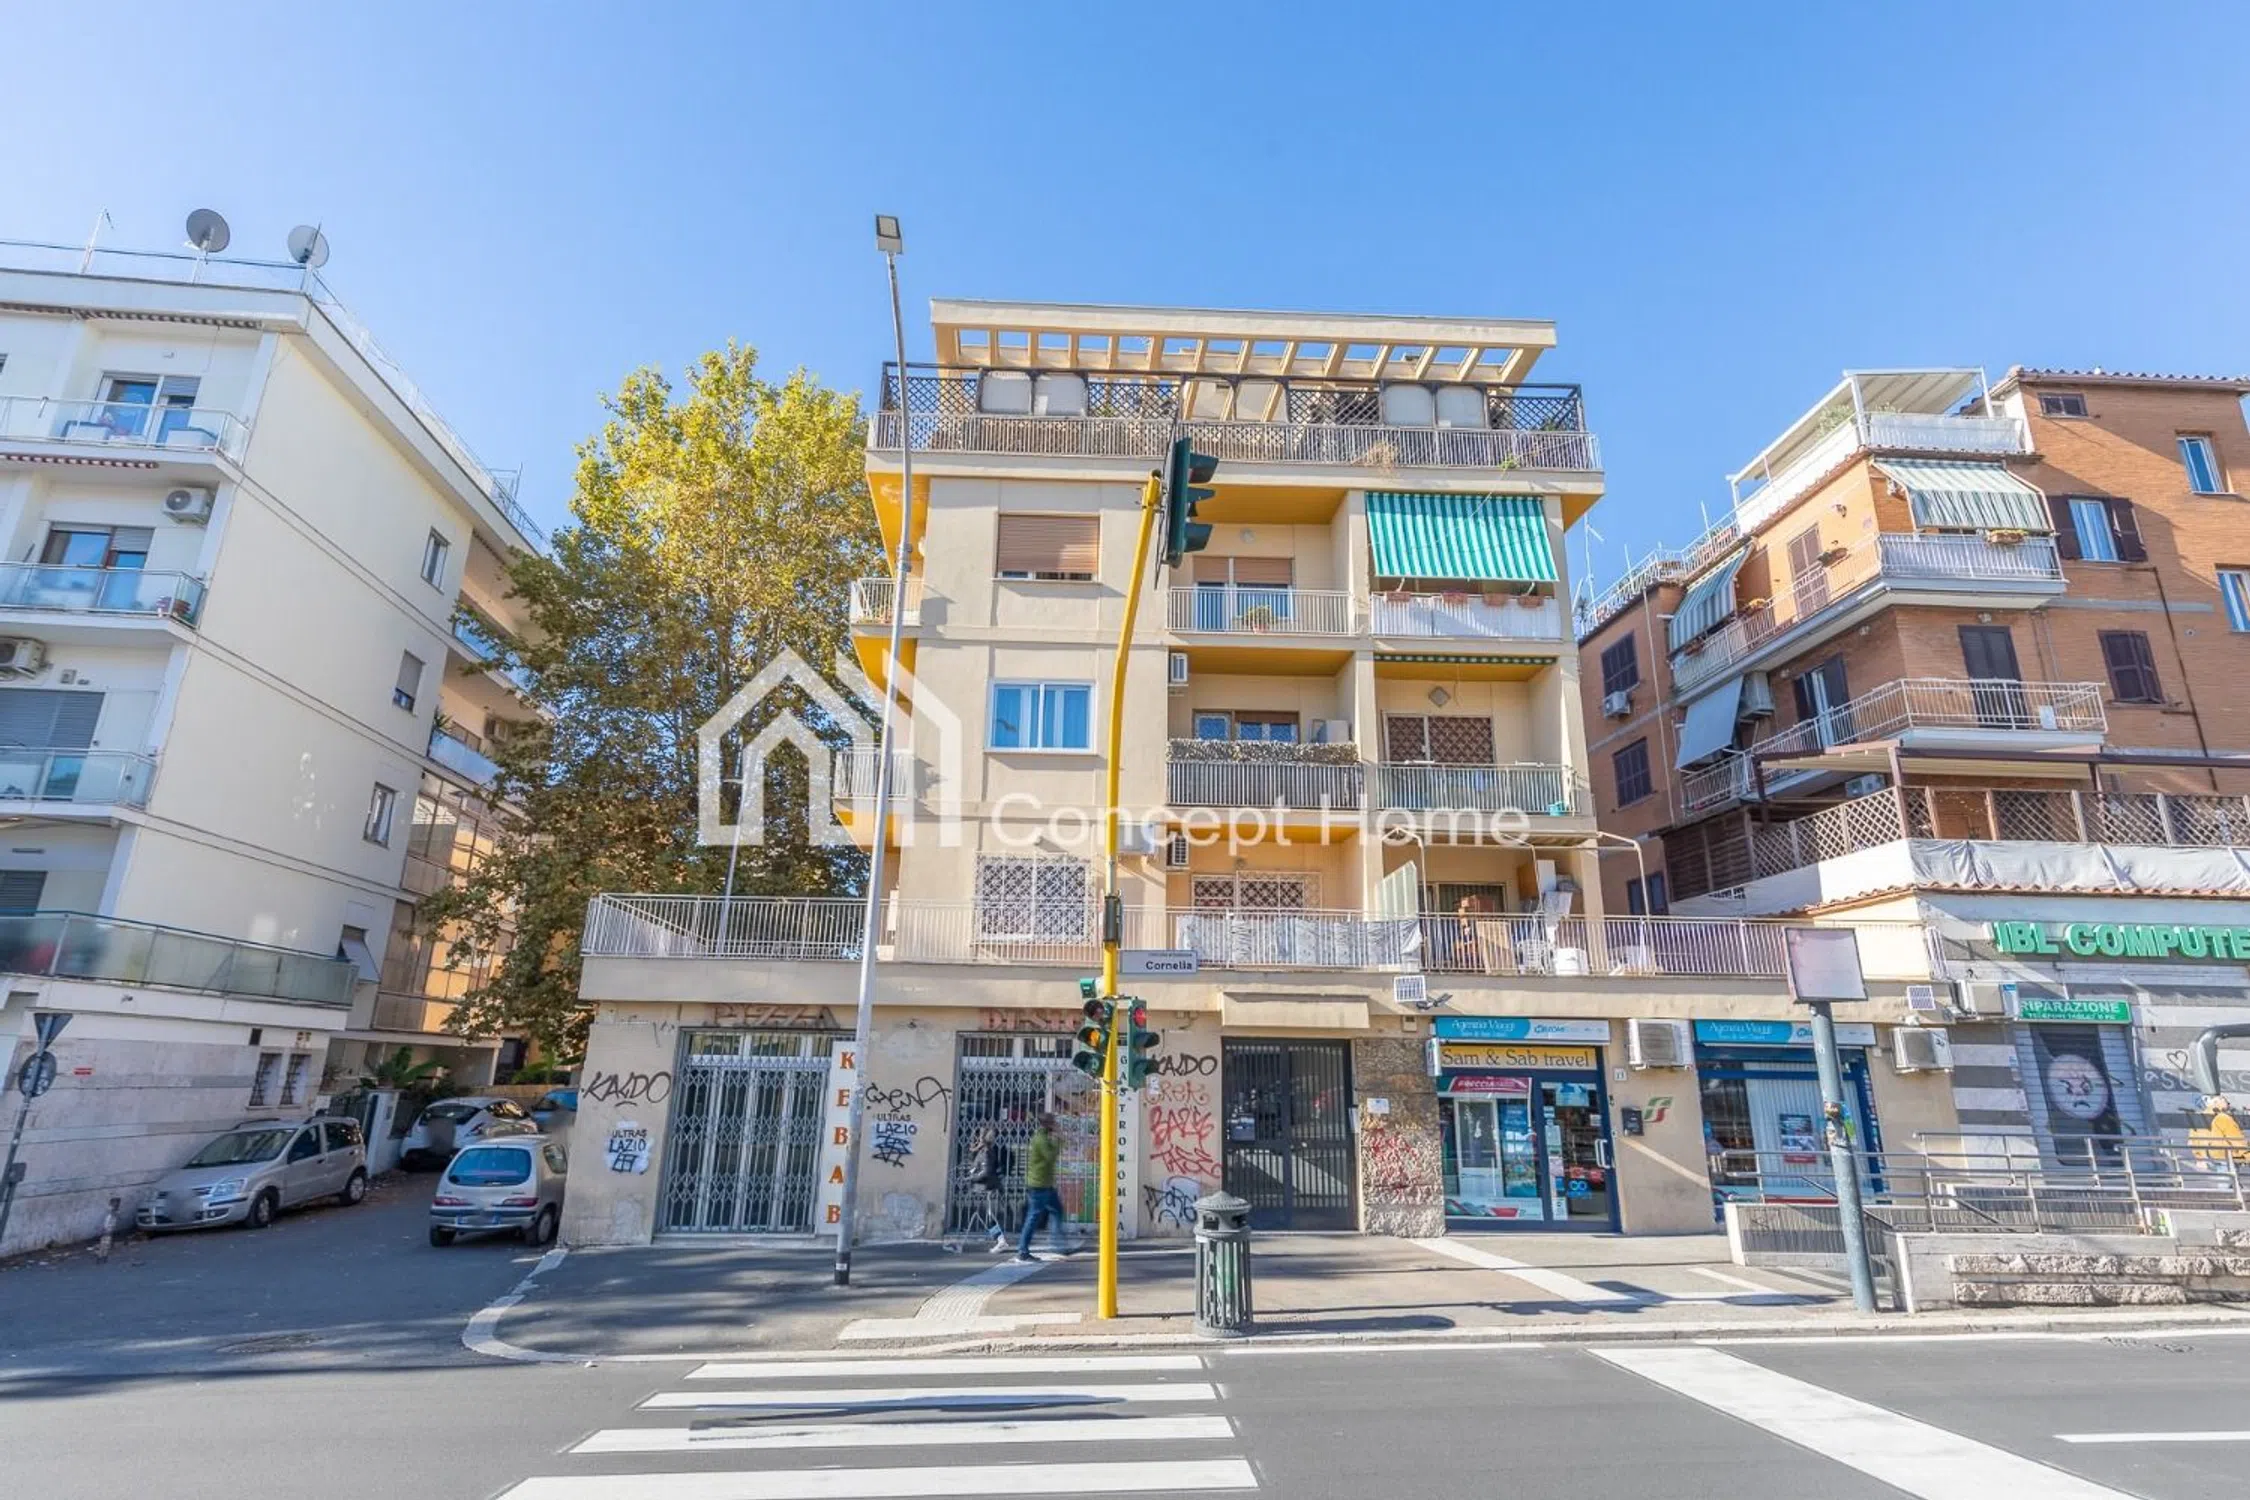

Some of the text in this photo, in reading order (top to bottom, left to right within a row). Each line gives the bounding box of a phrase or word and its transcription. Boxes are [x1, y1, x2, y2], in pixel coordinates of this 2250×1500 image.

[1994, 920, 2060, 954] IBL
[1145, 961, 1193, 971] Cornelia
[2020, 1001, 2119, 1013] RIPARAZIONE
[1441, 1048, 1480, 1066] Sam
[1485, 1049, 1503, 1066] &
[1506, 1049, 1538, 1066] Sab
[1544, 1050, 1590, 1067] travel
[876, 1113, 912, 1122] ULTRAS
[612, 1129, 648, 1138] ULTRAS
[876, 1123, 918, 1135] LAZIO
[825, 1051, 855, 1224] KEBAB
[609, 1138, 647, 1153] LAZIO
